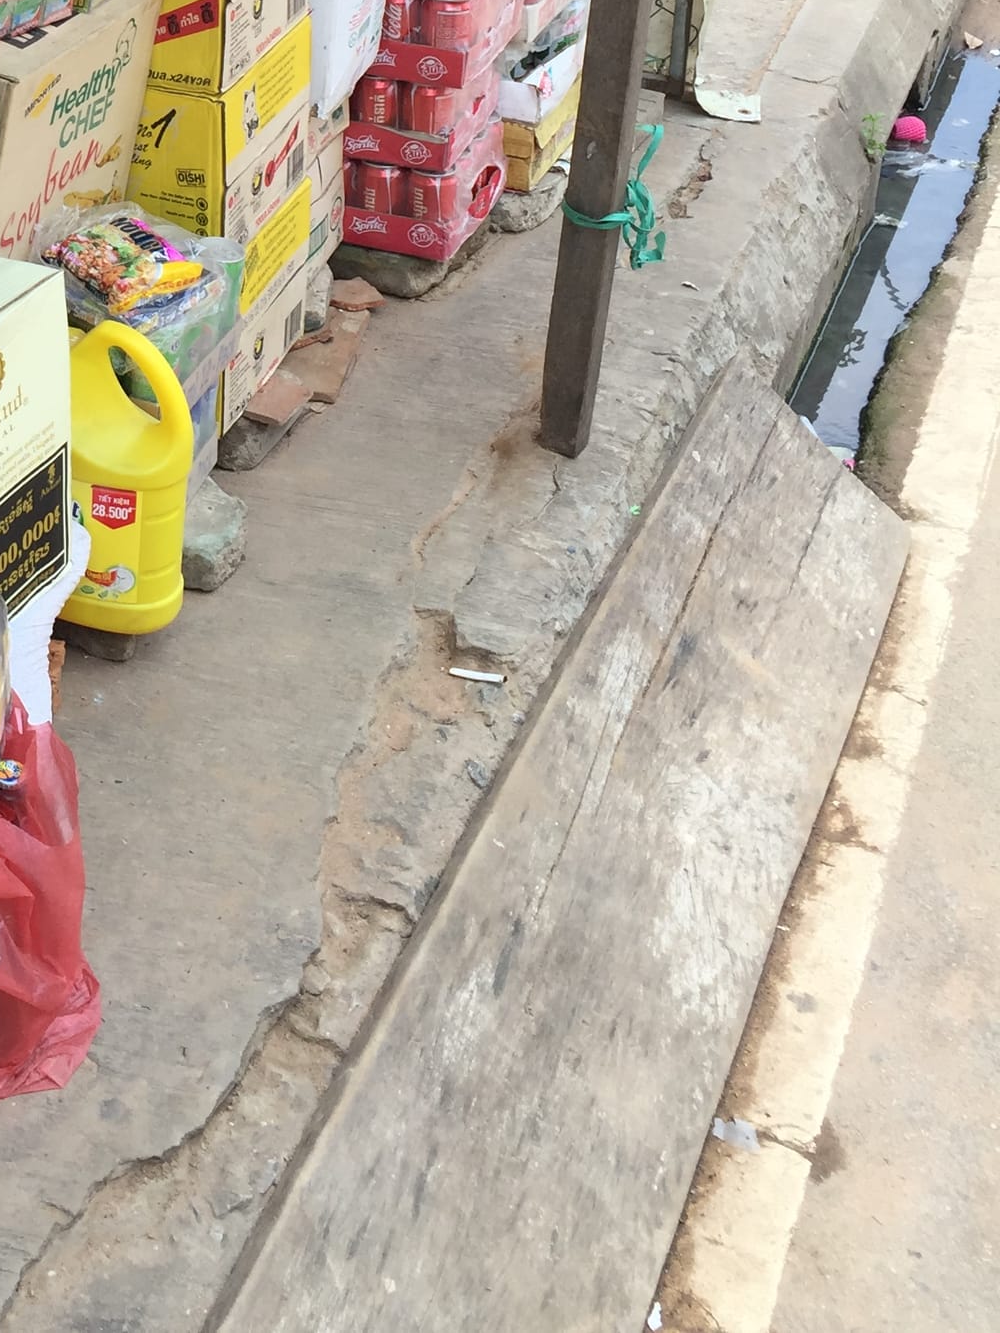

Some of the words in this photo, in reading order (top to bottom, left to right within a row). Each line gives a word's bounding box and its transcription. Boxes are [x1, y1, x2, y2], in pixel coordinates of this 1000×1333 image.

[50, 61, 120, 126] Healthy
[58, 92, 115, 148] CHEF
[151, 107, 177, 149] 1
[177, 172, 206, 184] OISHI
